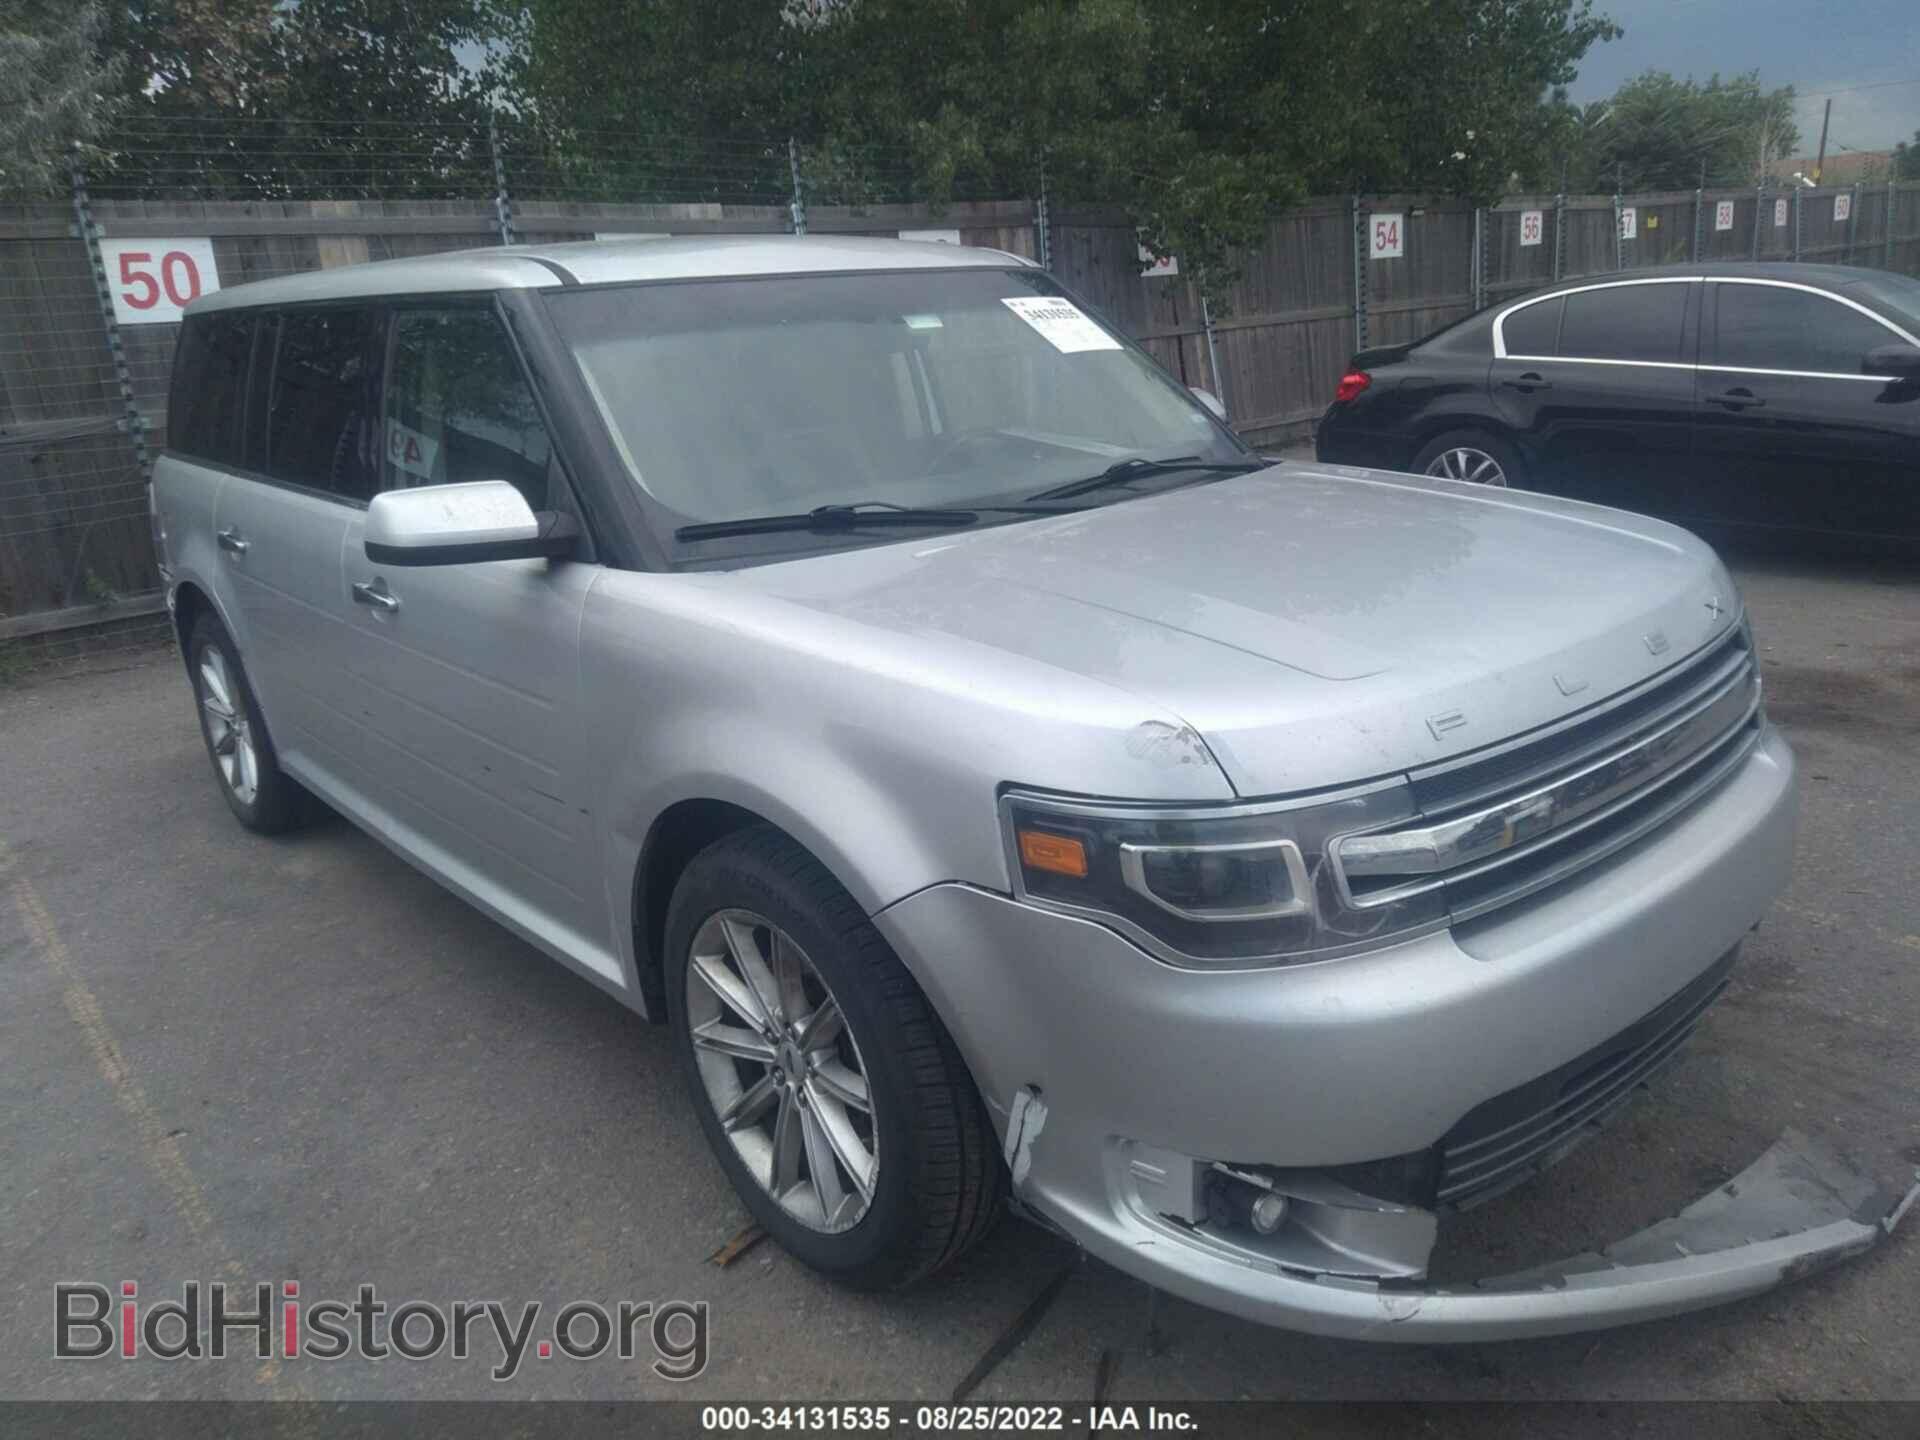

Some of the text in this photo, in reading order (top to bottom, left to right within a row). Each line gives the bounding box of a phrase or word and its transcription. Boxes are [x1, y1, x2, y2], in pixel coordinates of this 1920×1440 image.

[1376, 221, 1399, 250] 54
[1524, 216, 1539, 240] 56
[118, 251, 201, 310] 50
